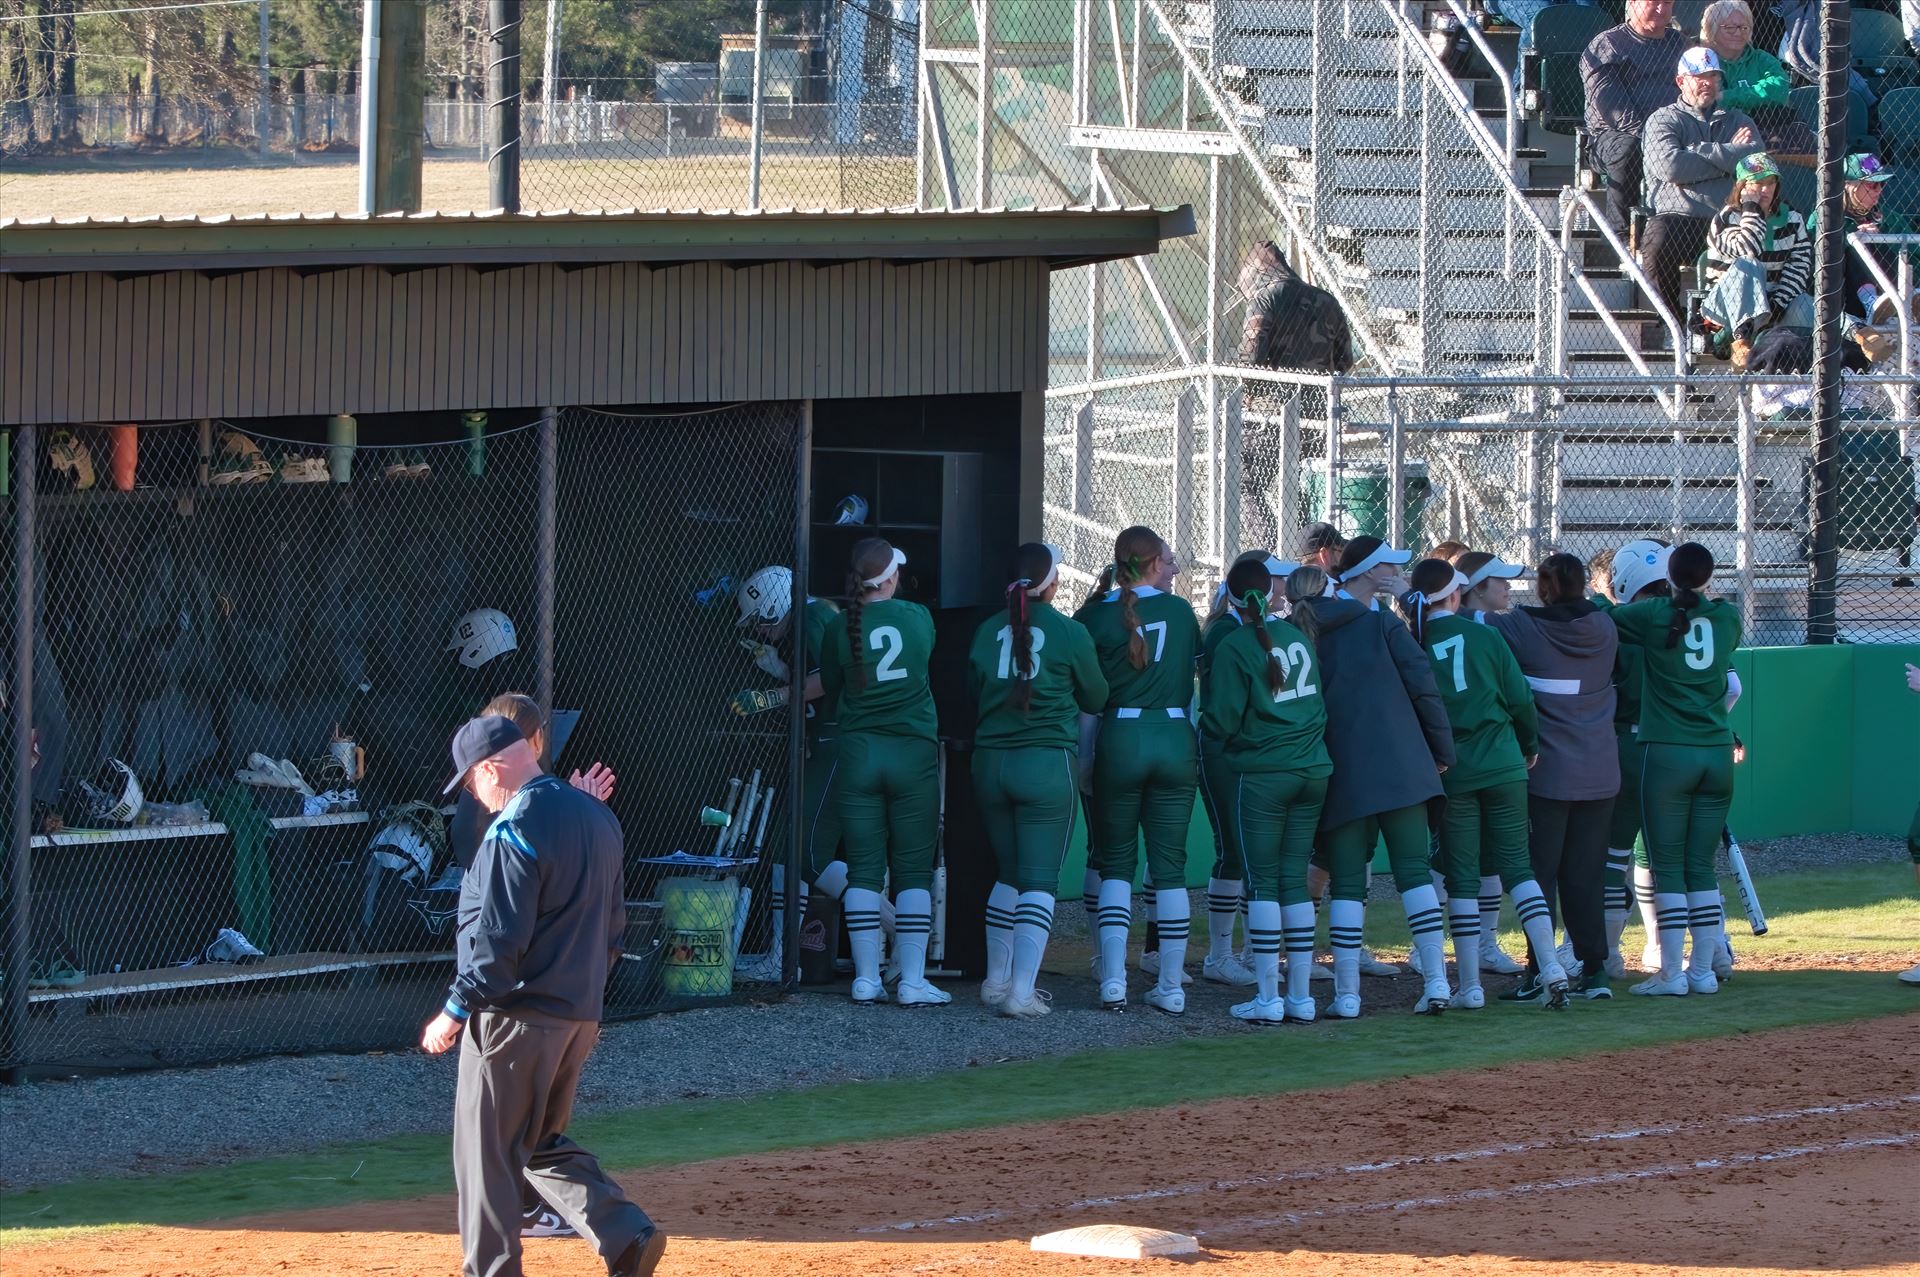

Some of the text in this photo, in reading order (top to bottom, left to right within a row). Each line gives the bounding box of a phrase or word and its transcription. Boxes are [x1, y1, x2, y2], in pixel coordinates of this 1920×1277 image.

[747, 585, 760, 600] 6
[869, 625, 908, 682] 2
[1431, 633, 1468, 693] 7
[1684, 616, 1714, 670] 9
[1266, 641, 1317, 703] 22
